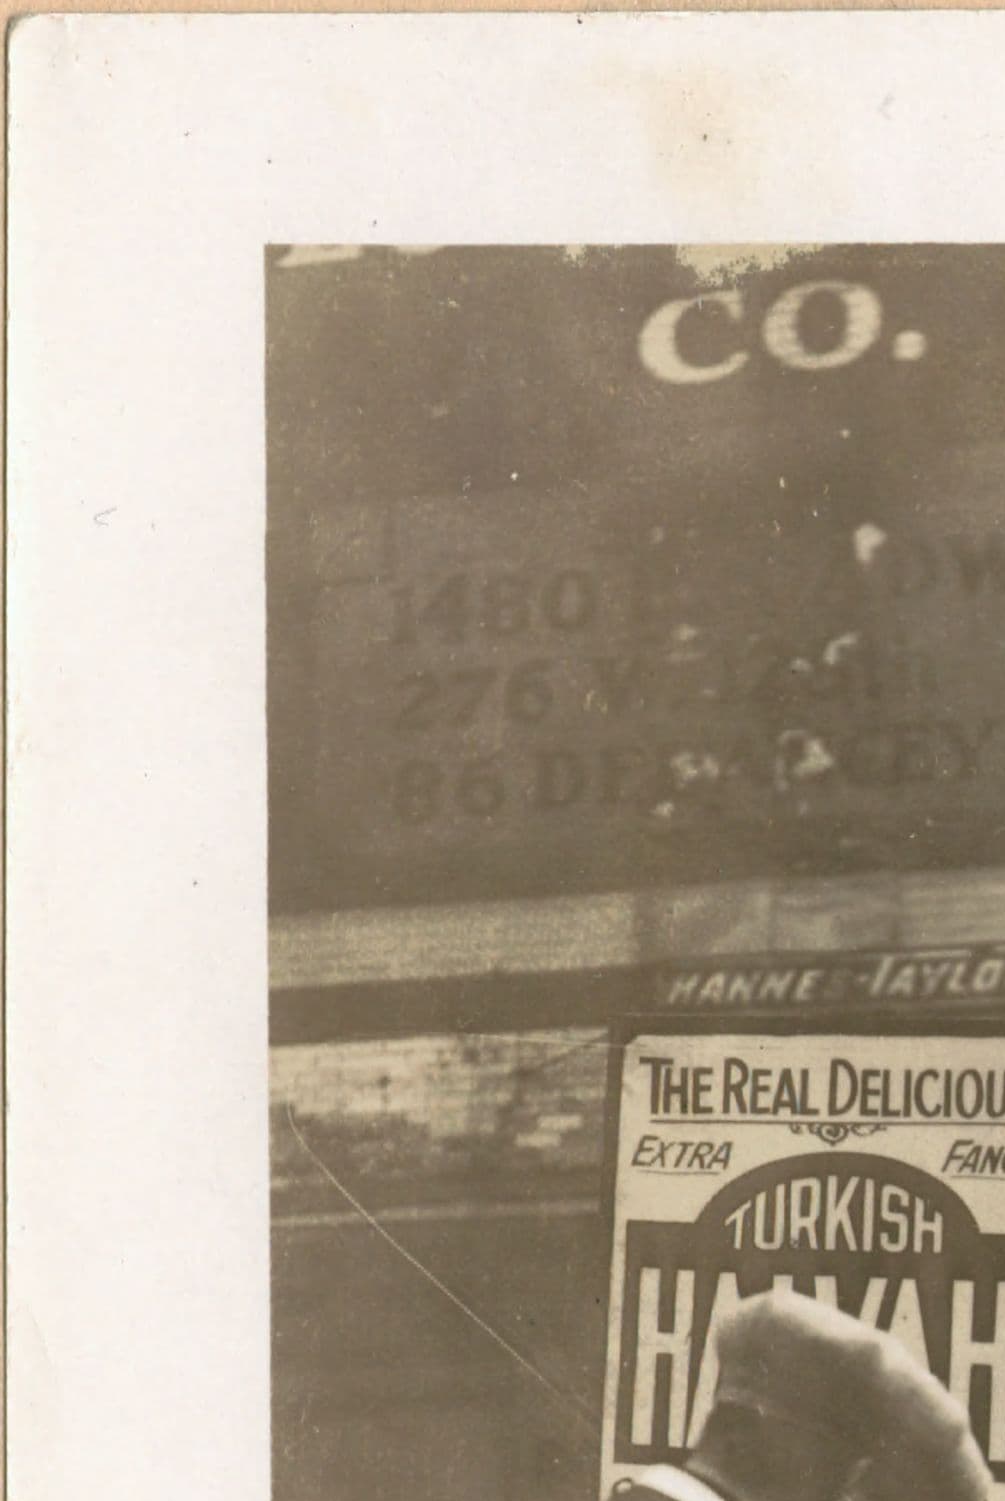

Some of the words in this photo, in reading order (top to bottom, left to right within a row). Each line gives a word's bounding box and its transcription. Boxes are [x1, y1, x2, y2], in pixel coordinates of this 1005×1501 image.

[635, 279, 929, 386] CO.
[390, 566, 598, 646] 1480
[392, 659, 554, 732] 276
[392, 756, 507, 826] 86
[639, 1056, 713, 1116] THE
[722, 1057, 819, 1117] REAL
[631, 1135, 733, 1171] EXTRA
[724, 1175, 944, 1255] TURKISH
